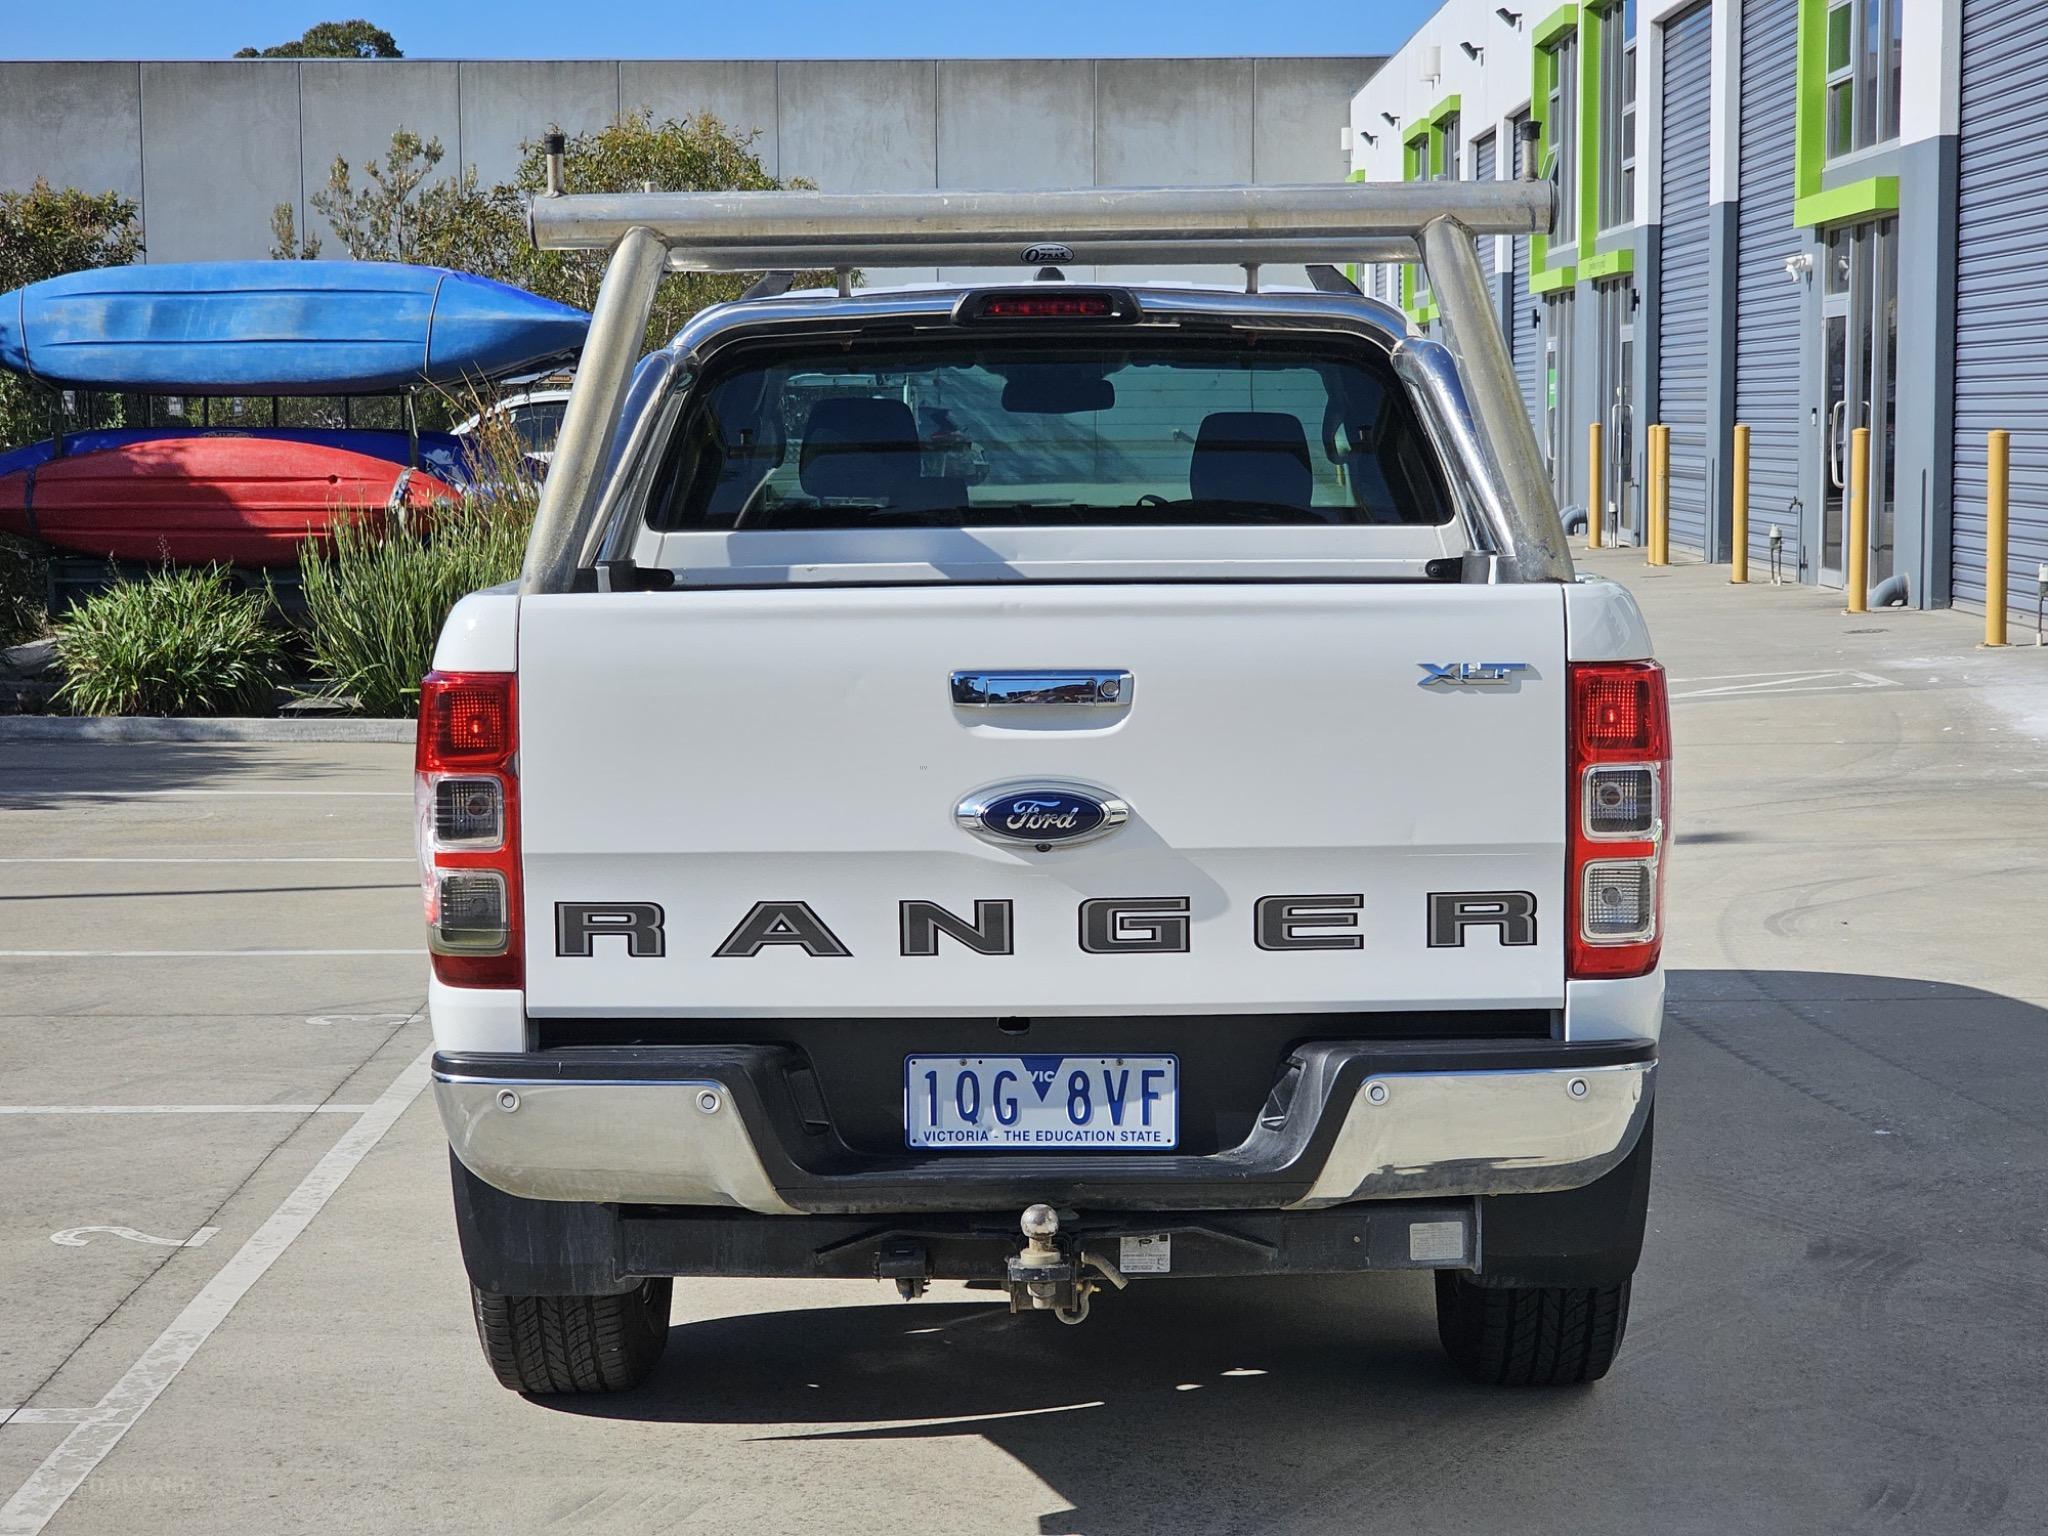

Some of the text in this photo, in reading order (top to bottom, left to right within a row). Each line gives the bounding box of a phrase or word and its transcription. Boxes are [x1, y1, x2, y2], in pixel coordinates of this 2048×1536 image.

[1417, 663, 1526, 685] XLT
[1006, 800, 1079, 830] Ford
[554, 891, 1537, 958] RANGER
[1029, 1070, 1055, 1082] VIC
[1067, 1069, 1165, 1126] 8VF
[924, 1130, 989, 1142] VICTORIA
[1005, 1130, 1030, 1142] THE
[1036, 1130, 1117, 1142] EDUCATION
[1120, 1130, 1161, 1142] STATE
